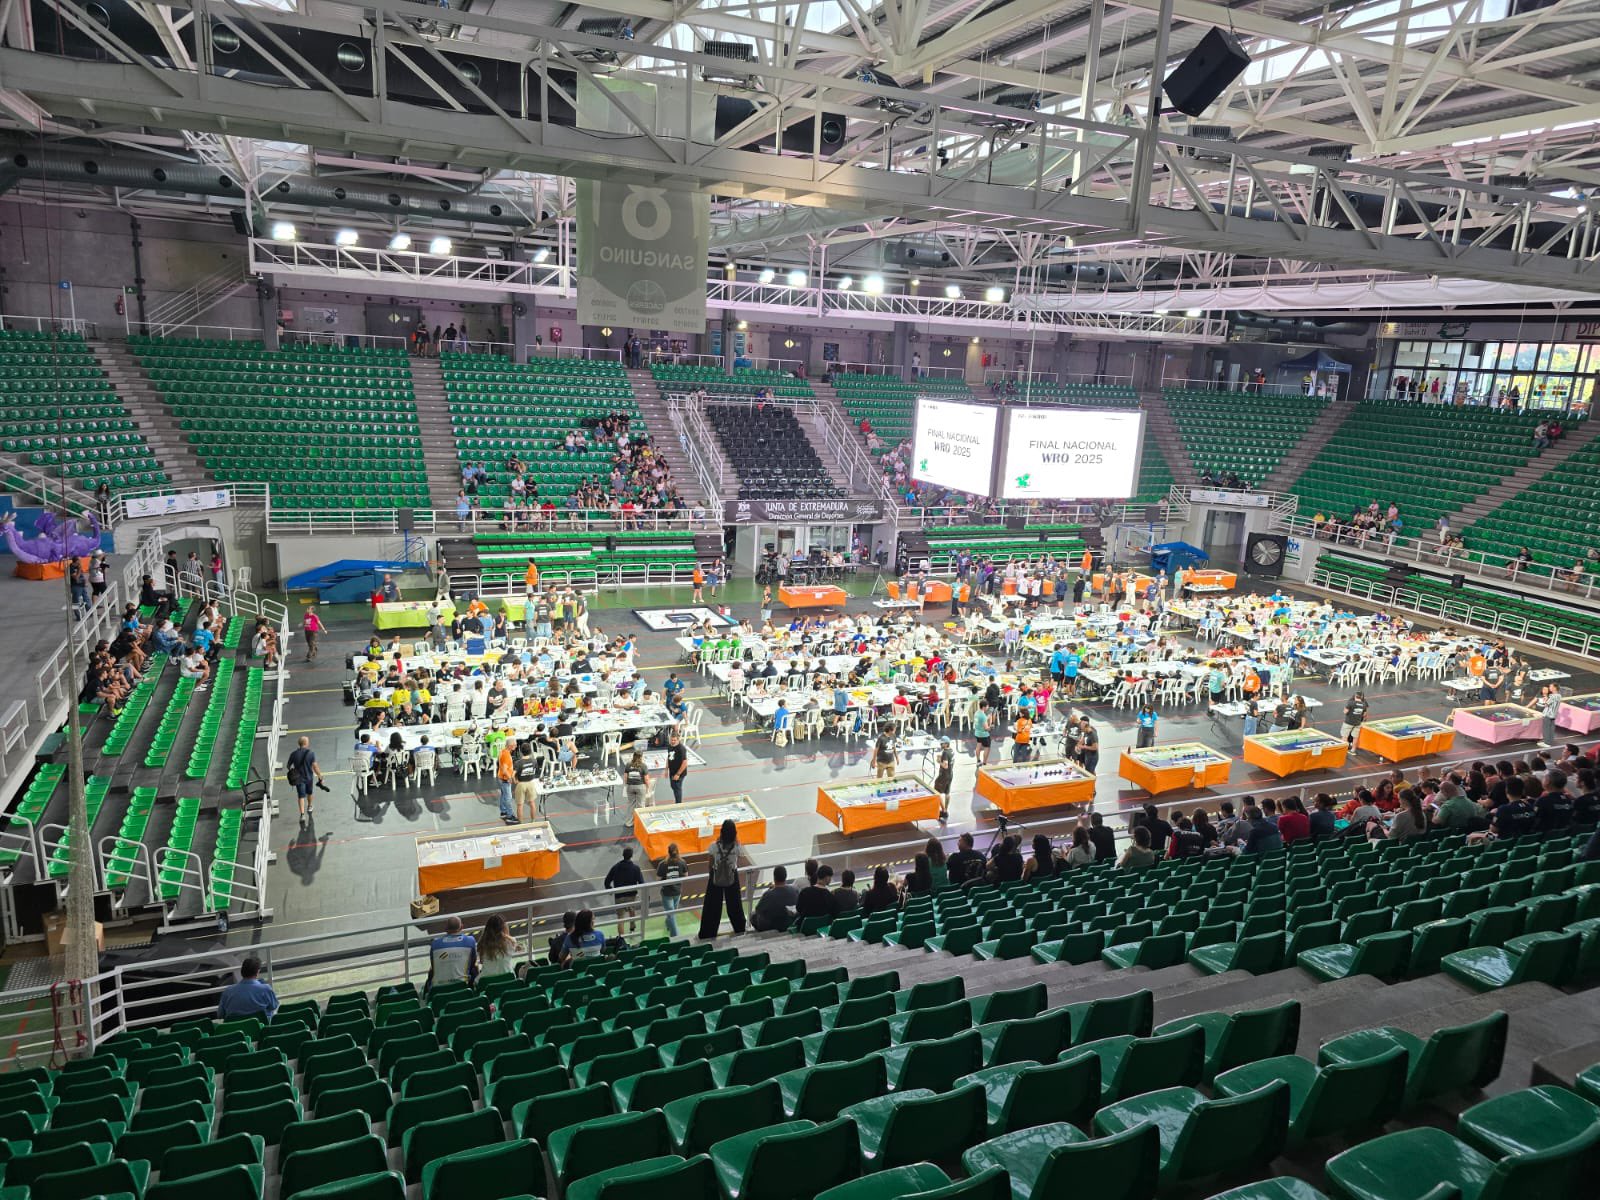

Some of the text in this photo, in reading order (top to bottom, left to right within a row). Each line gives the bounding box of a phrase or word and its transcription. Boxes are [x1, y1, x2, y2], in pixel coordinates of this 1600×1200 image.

[928, 428, 981, 445] FINAL NACIONAL
[934, 441, 971, 458] WRO 2025
[1029, 440, 1118, 451] FINAL NACIONAL
[1041, 452, 1103, 464] WRO 2025
[765, 502, 785, 512] JUNTA
[788, 503, 798, 511] DE
[800, 502, 848, 512] EXTREMADURA
